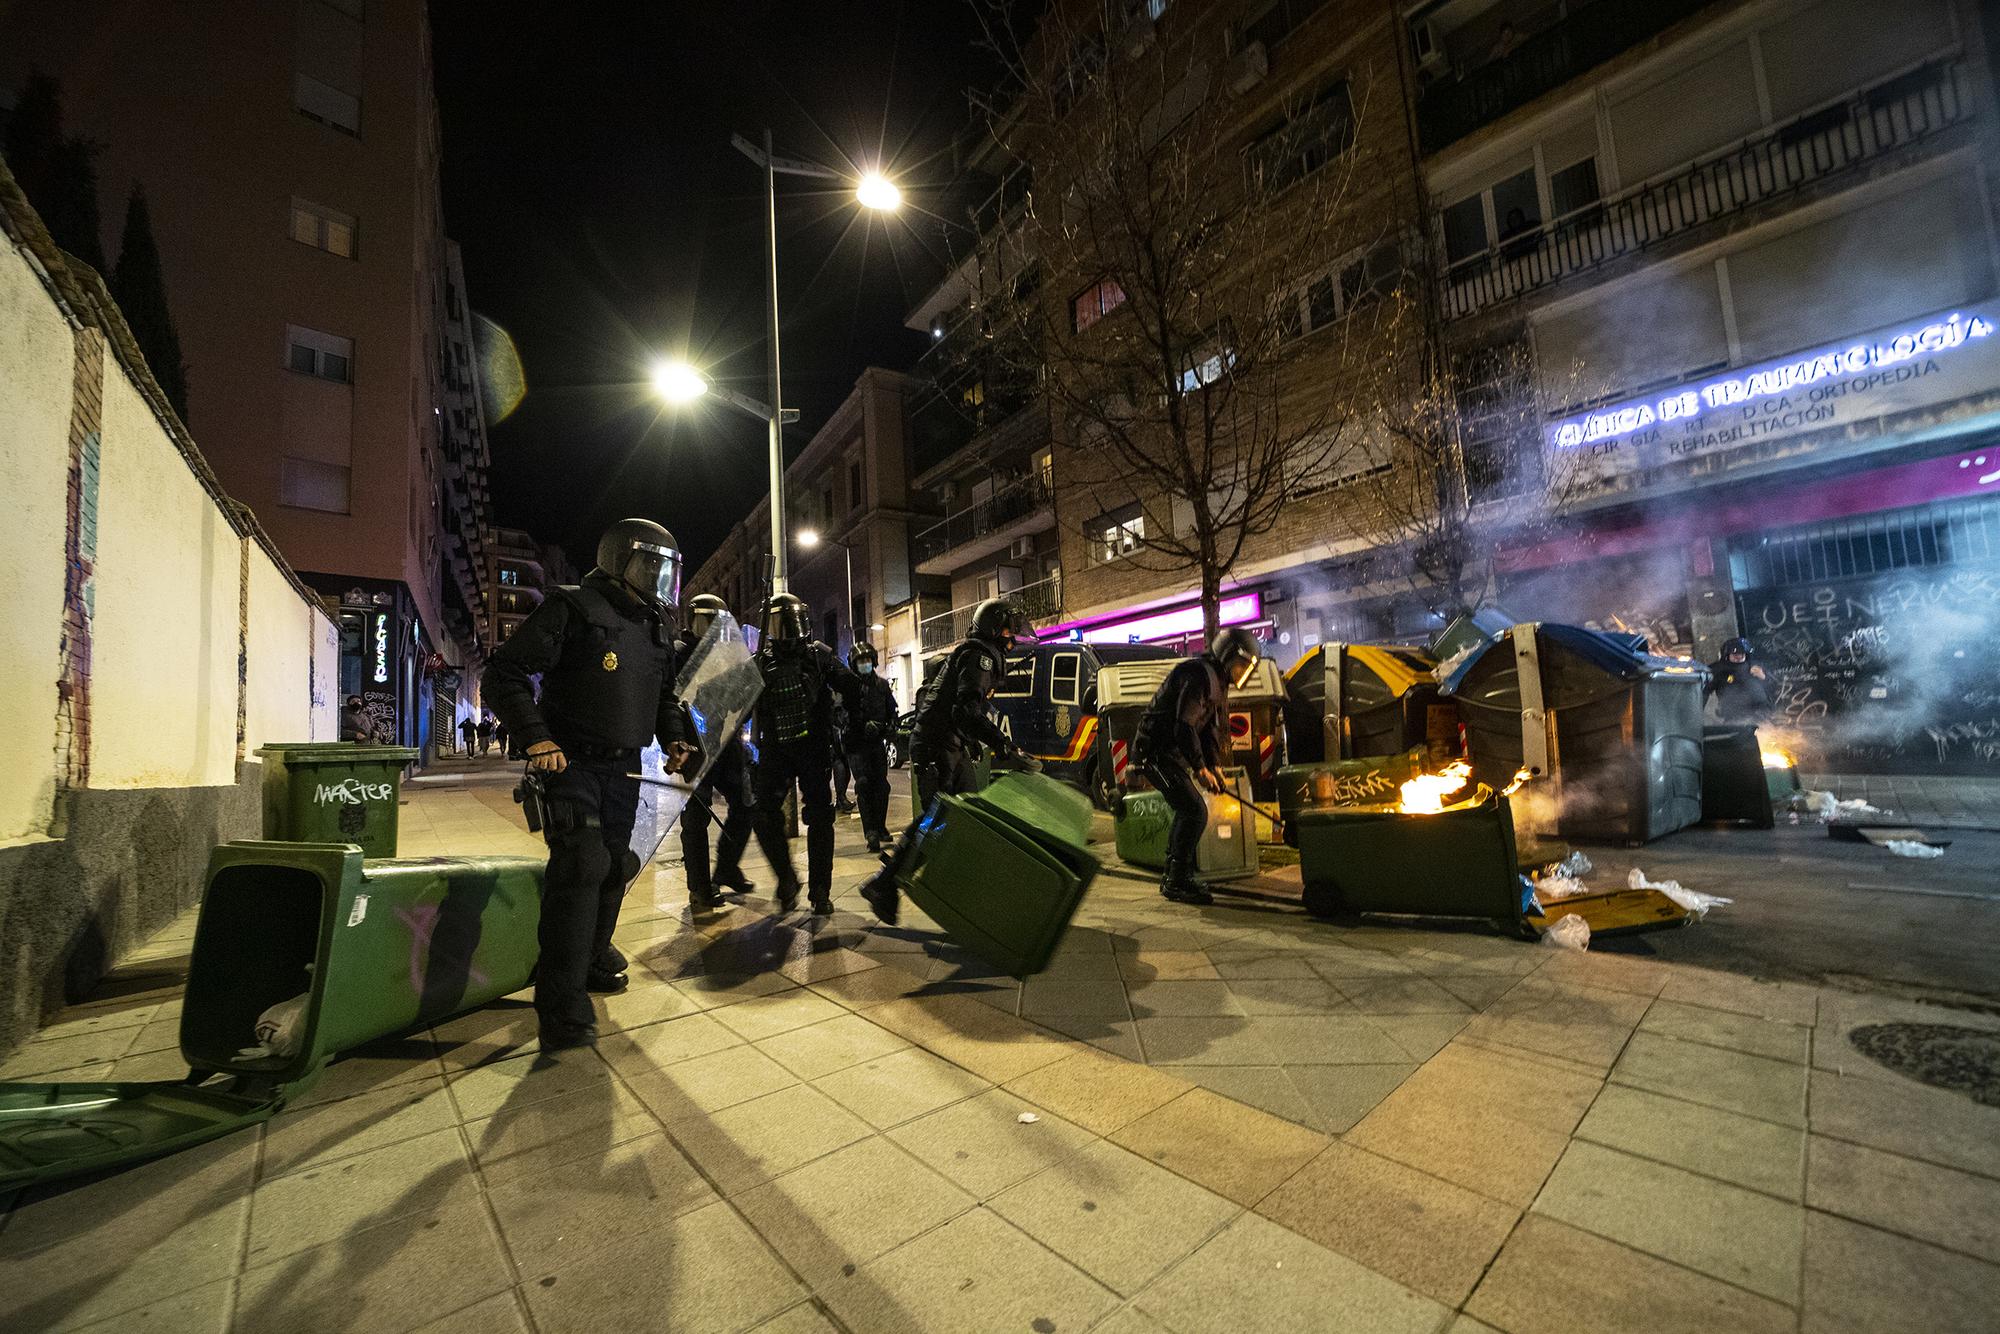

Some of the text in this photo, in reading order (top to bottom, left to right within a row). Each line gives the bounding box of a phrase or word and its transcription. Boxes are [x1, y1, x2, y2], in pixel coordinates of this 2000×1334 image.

[1658, 395, 1699, 421] DE
[1703, 312, 1993, 408] TRAUMATOLOGÍA
[1809, 359, 1940, 402] ORTOPEDIA
[1670, 402, 1836, 456] REHABILITACIÓN
[376, 614, 387, 677] PICASSO
